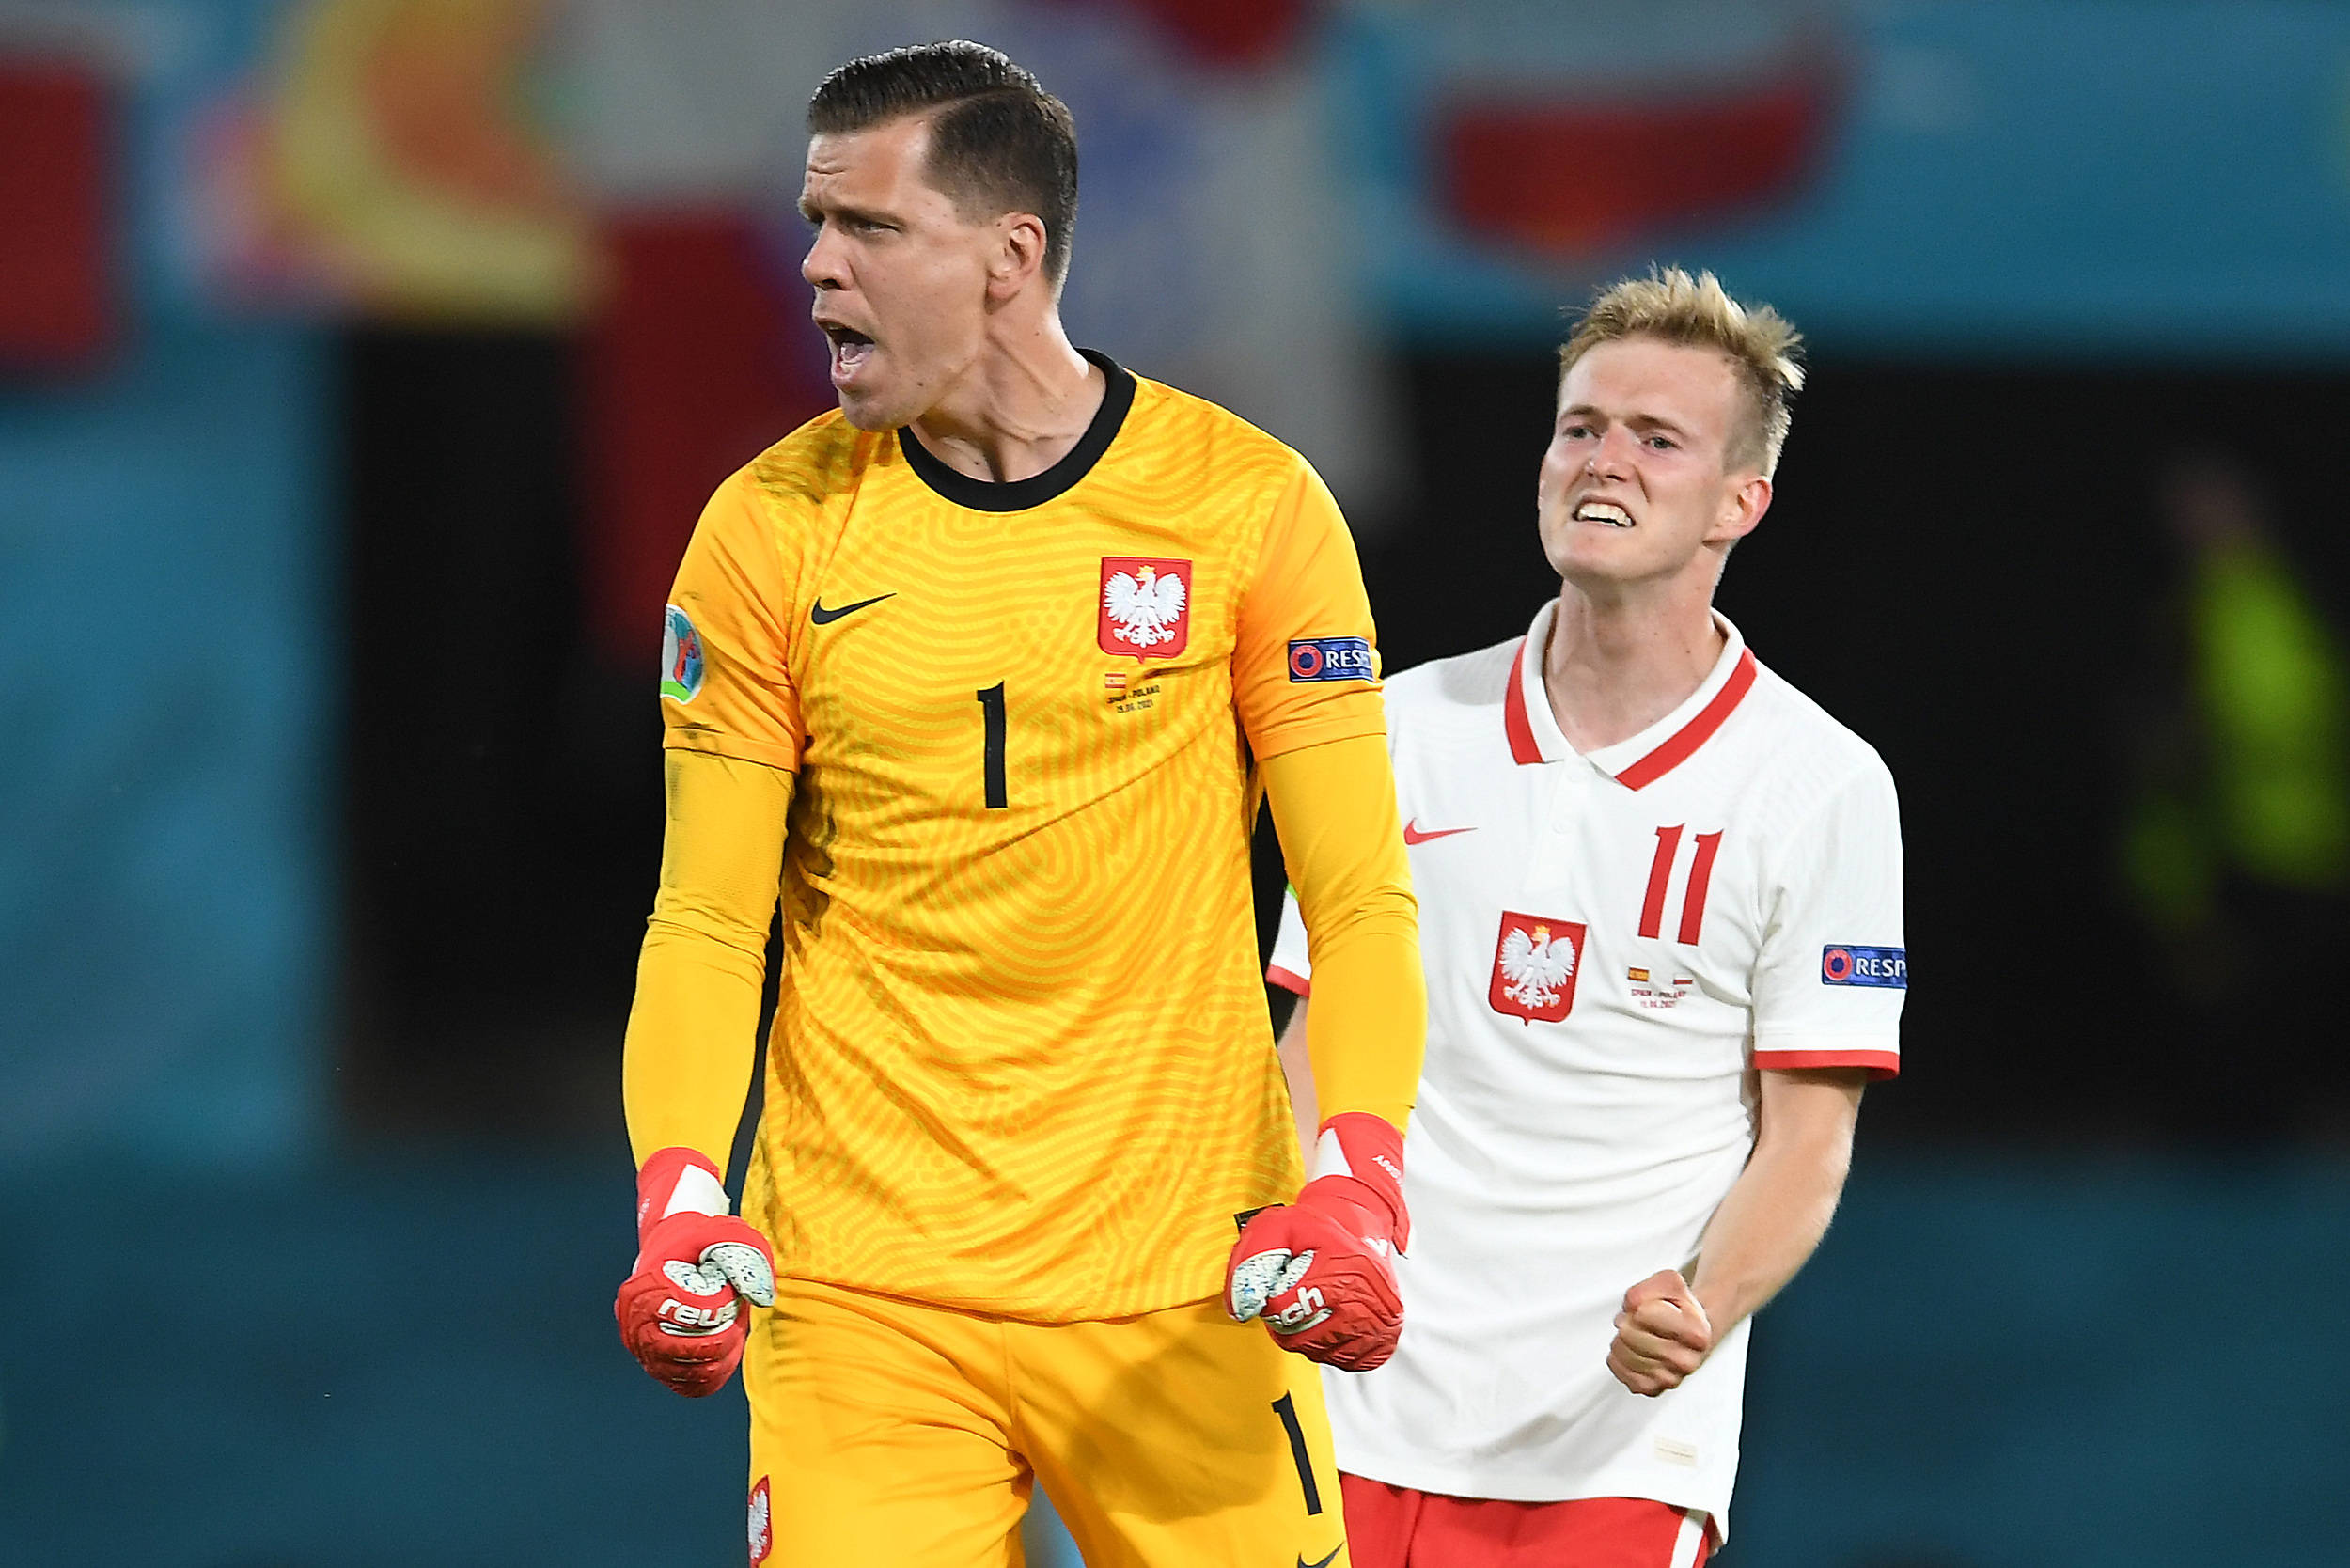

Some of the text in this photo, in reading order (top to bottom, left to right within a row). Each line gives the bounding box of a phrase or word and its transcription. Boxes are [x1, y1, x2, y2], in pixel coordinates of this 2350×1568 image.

[977, 680, 1008, 808] 1
[1638, 823, 1724, 946] 11
[1273, 1287, 1325, 1326] ch
[1271, 1389, 1323, 1515] 1
